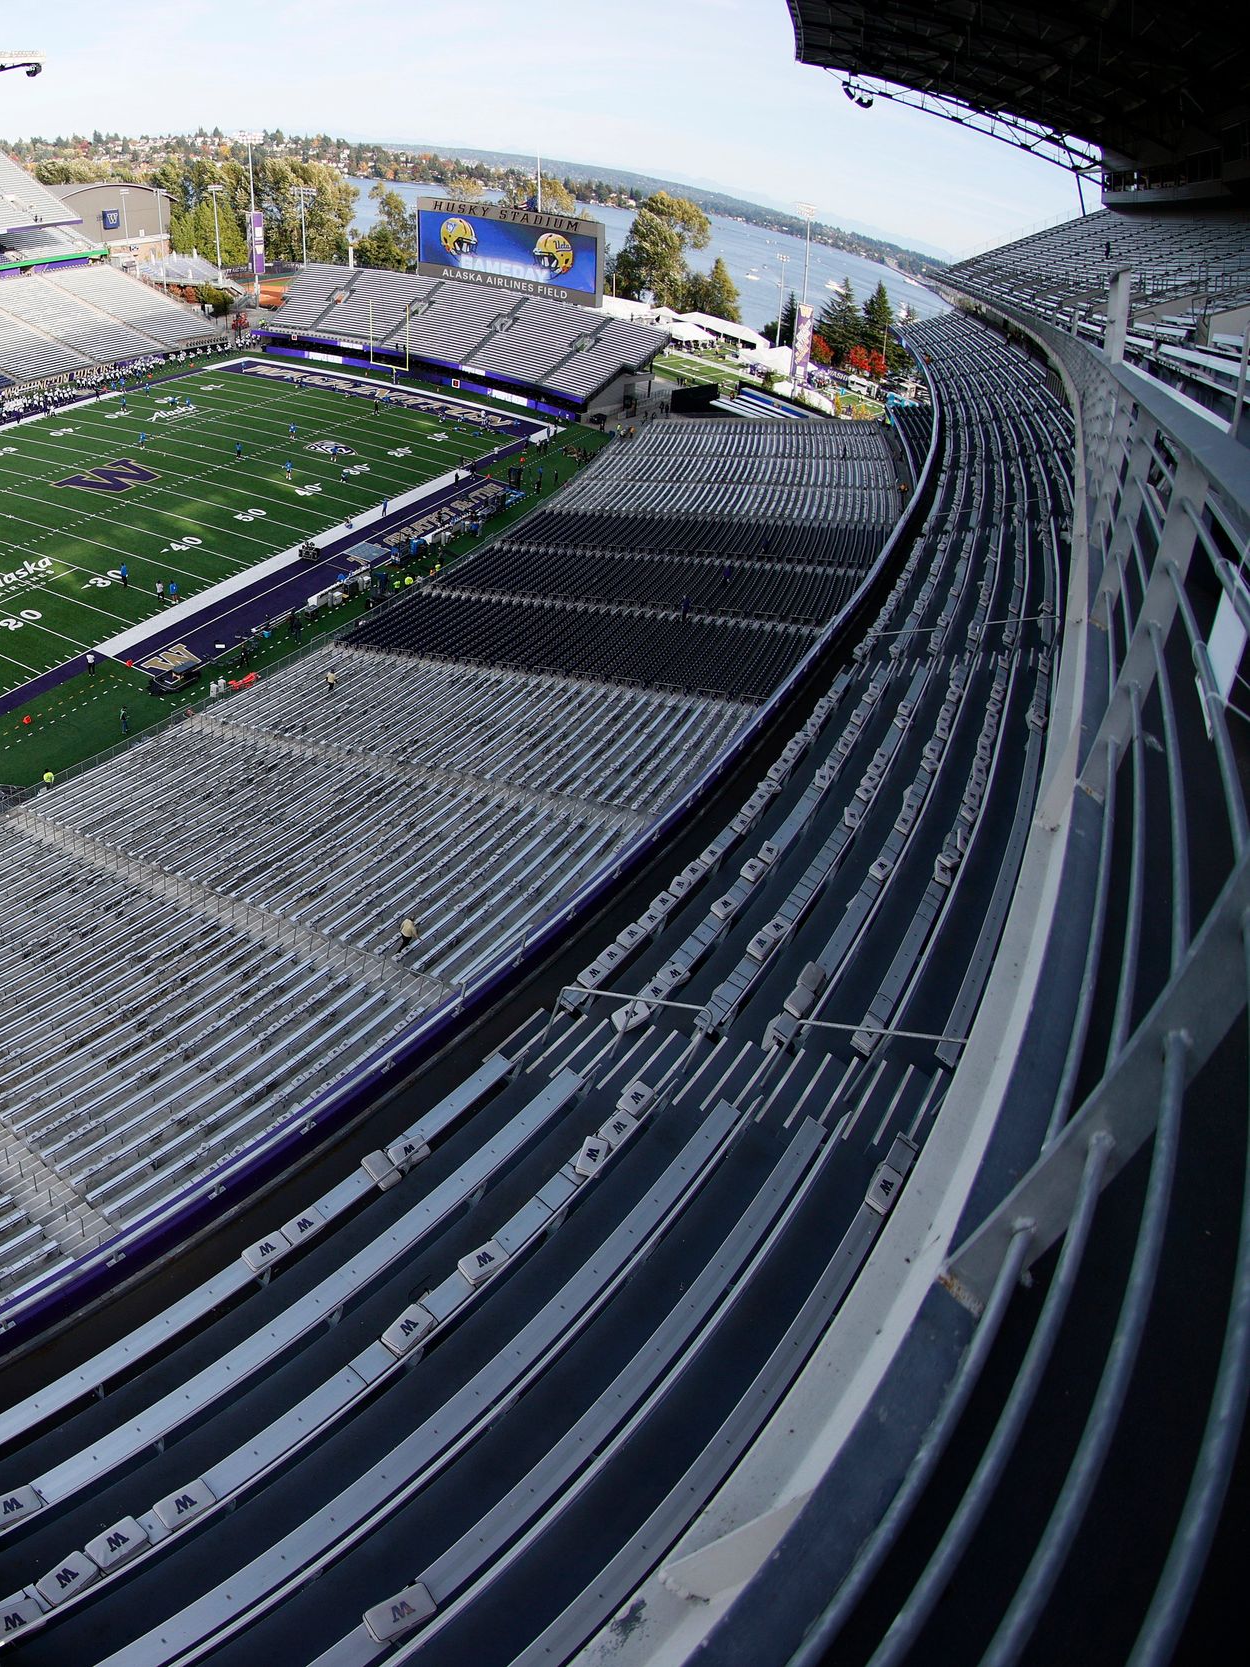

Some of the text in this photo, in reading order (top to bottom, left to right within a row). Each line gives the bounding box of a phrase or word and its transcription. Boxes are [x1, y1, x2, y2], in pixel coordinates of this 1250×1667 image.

[433, 201, 581, 232] HUSKY STADIUM
[442, 268, 568, 300] ALASKA AIRLINES FIELD
[49, 458, 162, 494] W
[0, 609, 43, 631] 20
[140, 643, 202, 671] W
[651, 986, 663, 998] W
[631, 1091, 645, 1105] W
[613, 1121, 628, 1134] W
[586, 1147, 601, 1162] W
[879, 1179, 895, 1197] W
[297, 1217, 314, 1233] W
[259, 1242, 277, 1257] W
[475, 1251, 495, 1268] W
[399, 1318, 419, 1337] W
[2, 1497, 24, 1515] W
[174, 1494, 197, 1514] W
[105, 1531, 130, 1553] W
[55, 1567, 80, 1589] W
[391, 1601, 416, 1623] W
[4, 1612, 27, 1632] W
